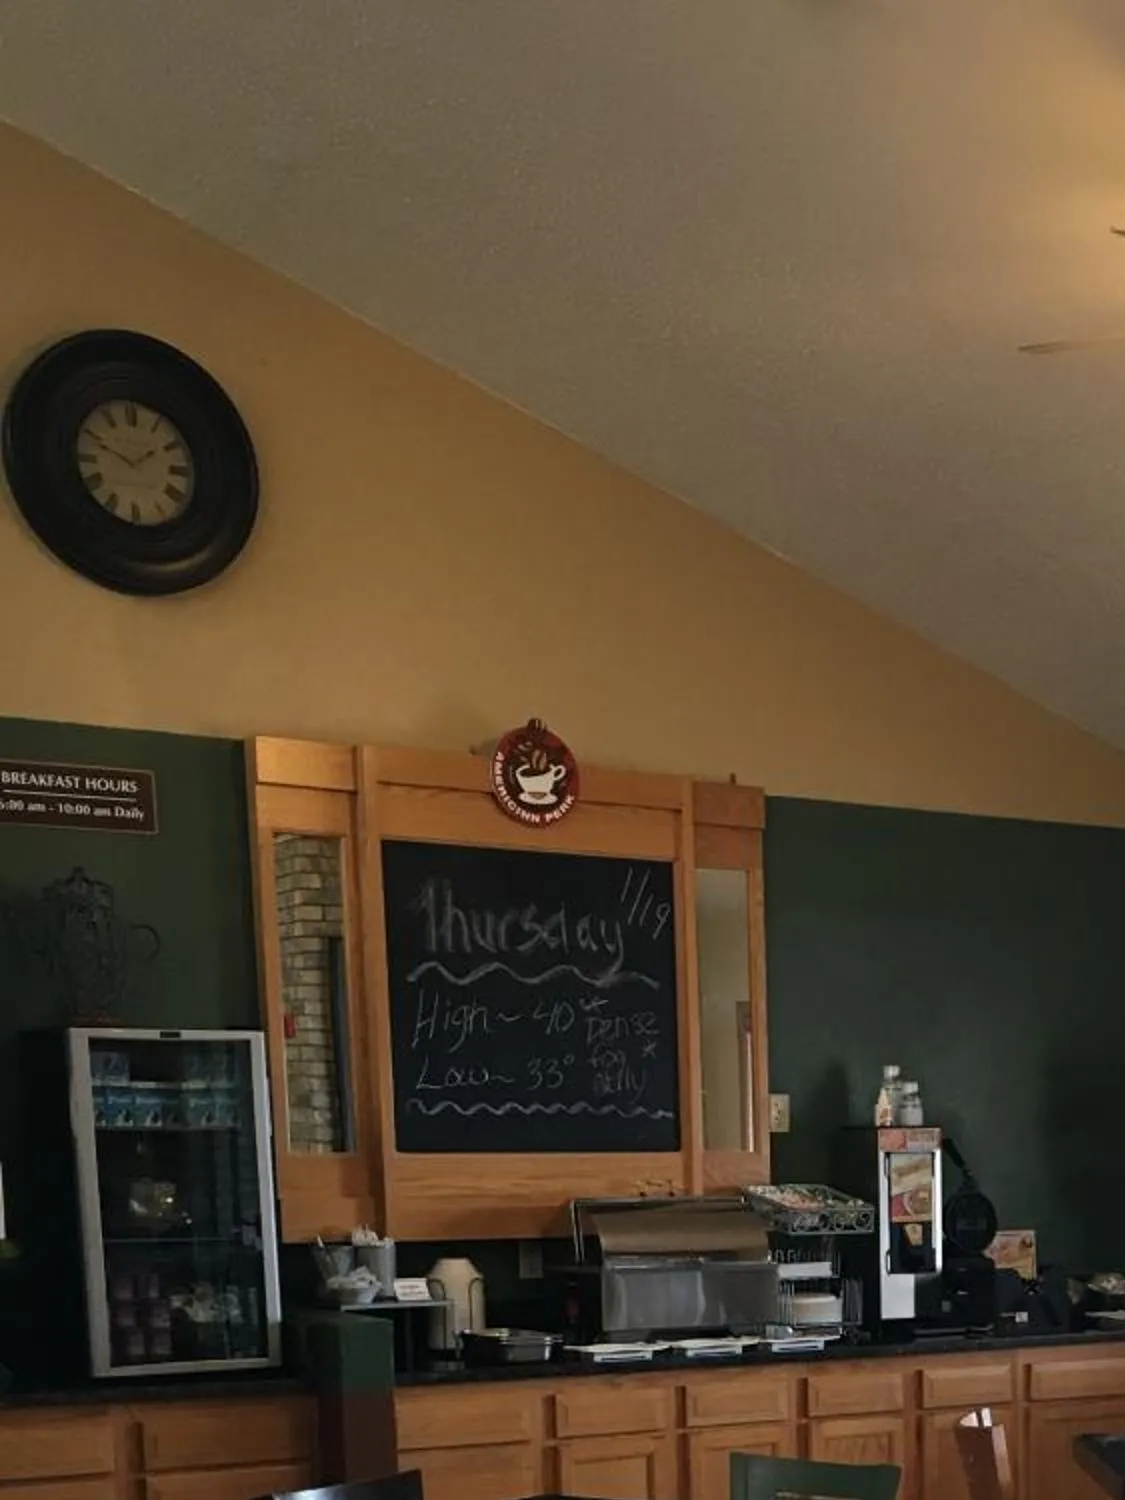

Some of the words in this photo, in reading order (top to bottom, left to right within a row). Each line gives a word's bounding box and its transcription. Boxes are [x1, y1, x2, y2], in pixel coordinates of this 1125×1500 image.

[1, 771, 80, 789] BREAKFAST
[85, 777, 138, 793] HOURS
[27, 803, 46, 812] am
[59, 803, 91, 815] 10:00
[93, 807, 111, 817] am
[114, 805, 145, 821] Daily
[418, 878, 624, 980] Thursday
[411, 988, 493, 1052] High
[416, 1053, 489, 1090] Low
